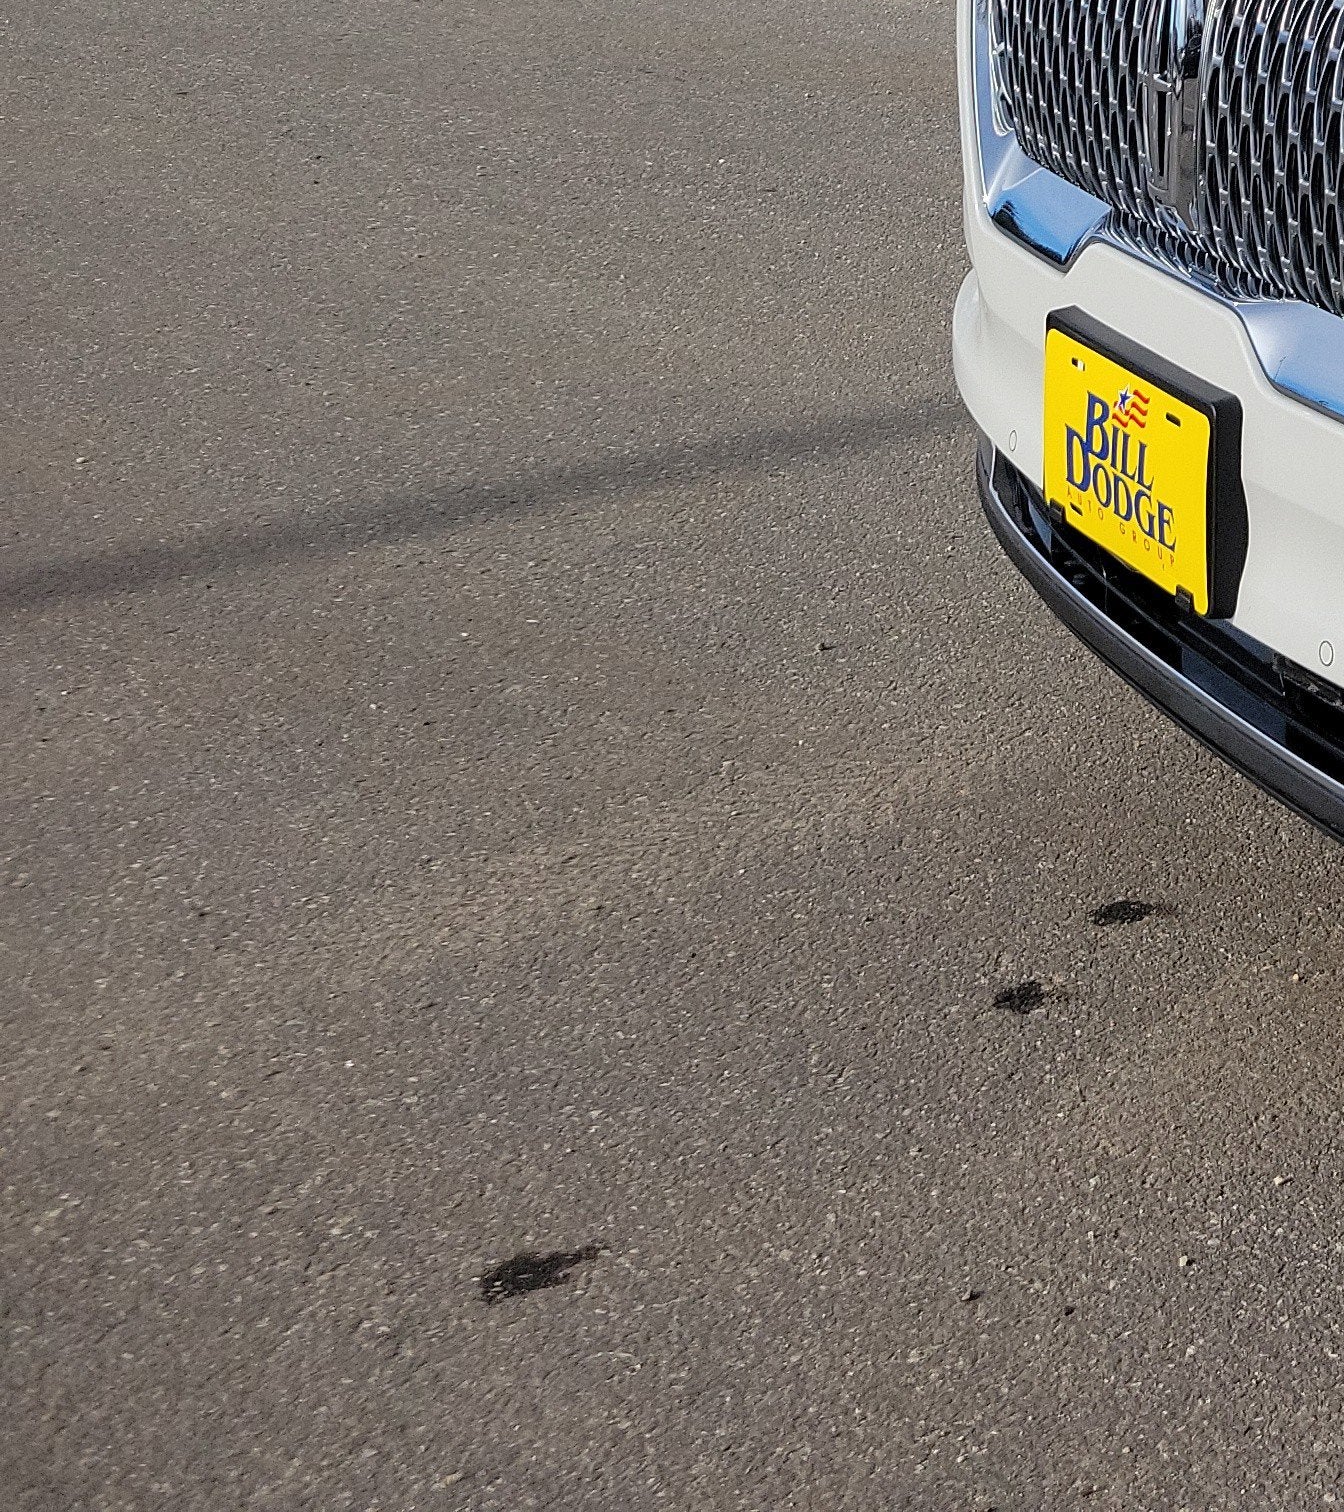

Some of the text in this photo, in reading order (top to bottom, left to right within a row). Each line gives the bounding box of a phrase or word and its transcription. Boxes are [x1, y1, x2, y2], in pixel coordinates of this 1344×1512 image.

[1065, 423, 1177, 553] DODGE
[1086, 390, 1155, 491] BILL
[1066, 486, 1176, 567] AUTO GROUP
